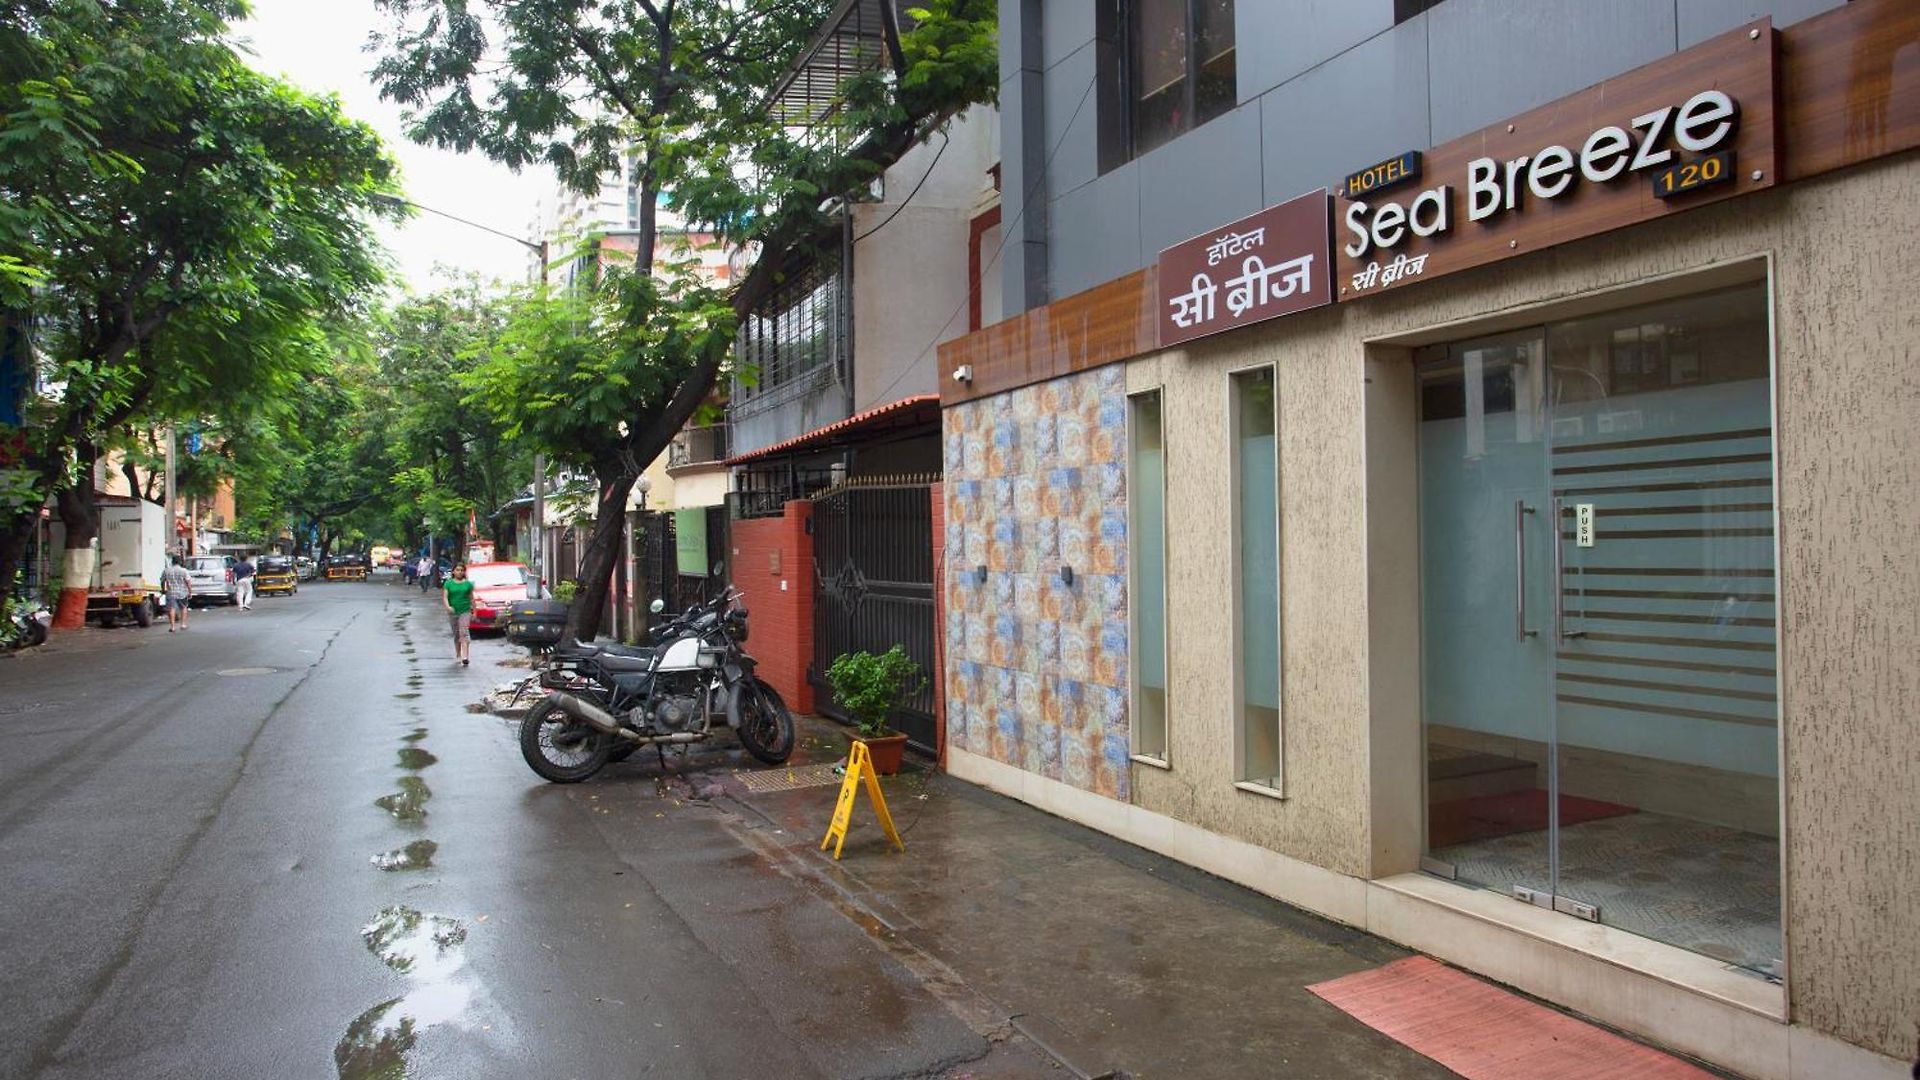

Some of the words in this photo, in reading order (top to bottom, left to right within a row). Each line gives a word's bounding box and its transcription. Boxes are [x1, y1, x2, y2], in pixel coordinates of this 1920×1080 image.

[1344, 184, 1446, 258] Sea
[1467, 90, 1734, 222] Breeze
[1350, 159, 1409, 194] HOTEL
[1661, 158, 1720, 192] 120
[1206, 227, 1266, 267] हॉटेल
[1169, 272, 1218, 328] सी
[1225, 255, 1314, 318] ब्रीज
[1351, 261, 1381, 291] सी
[1381, 253, 1429, 287] ब्रीज
